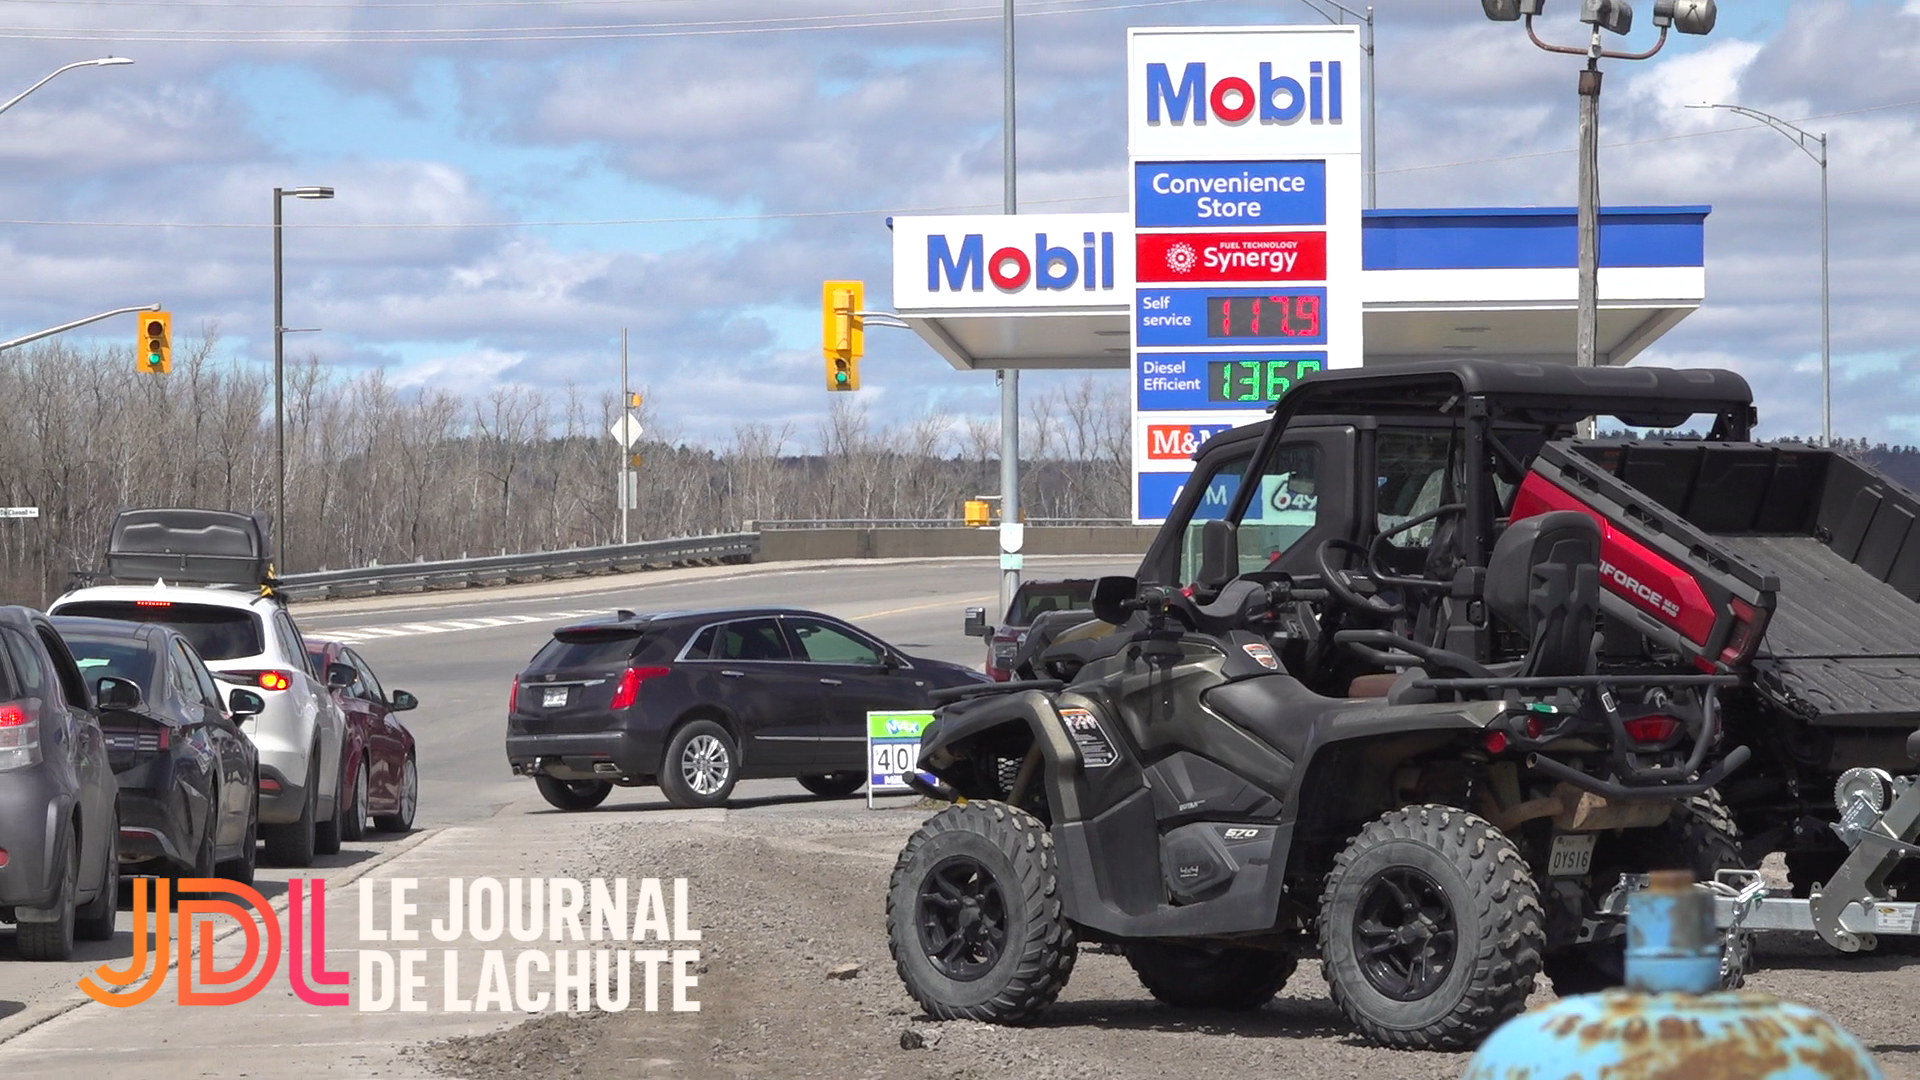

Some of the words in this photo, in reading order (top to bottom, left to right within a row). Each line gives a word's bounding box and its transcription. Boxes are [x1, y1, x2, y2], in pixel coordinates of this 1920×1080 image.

[1146, 61, 1342, 127] Mobil
[1152, 171, 1306, 194] Convenience
[1197, 197, 1262, 218] Store
[1242, 241, 1298, 249] TECHNOLOGY
[927, 232, 1114, 294] Mobil
[1203, 246, 1298, 273] Synergy
[1143, 296, 1171, 309] Self
[1143, 313, 1192, 326] service
[1143, 360, 1186, 374] Diesel
[1143, 377, 1201, 391] Efficient
[1225, 828, 1259, 837] 570
